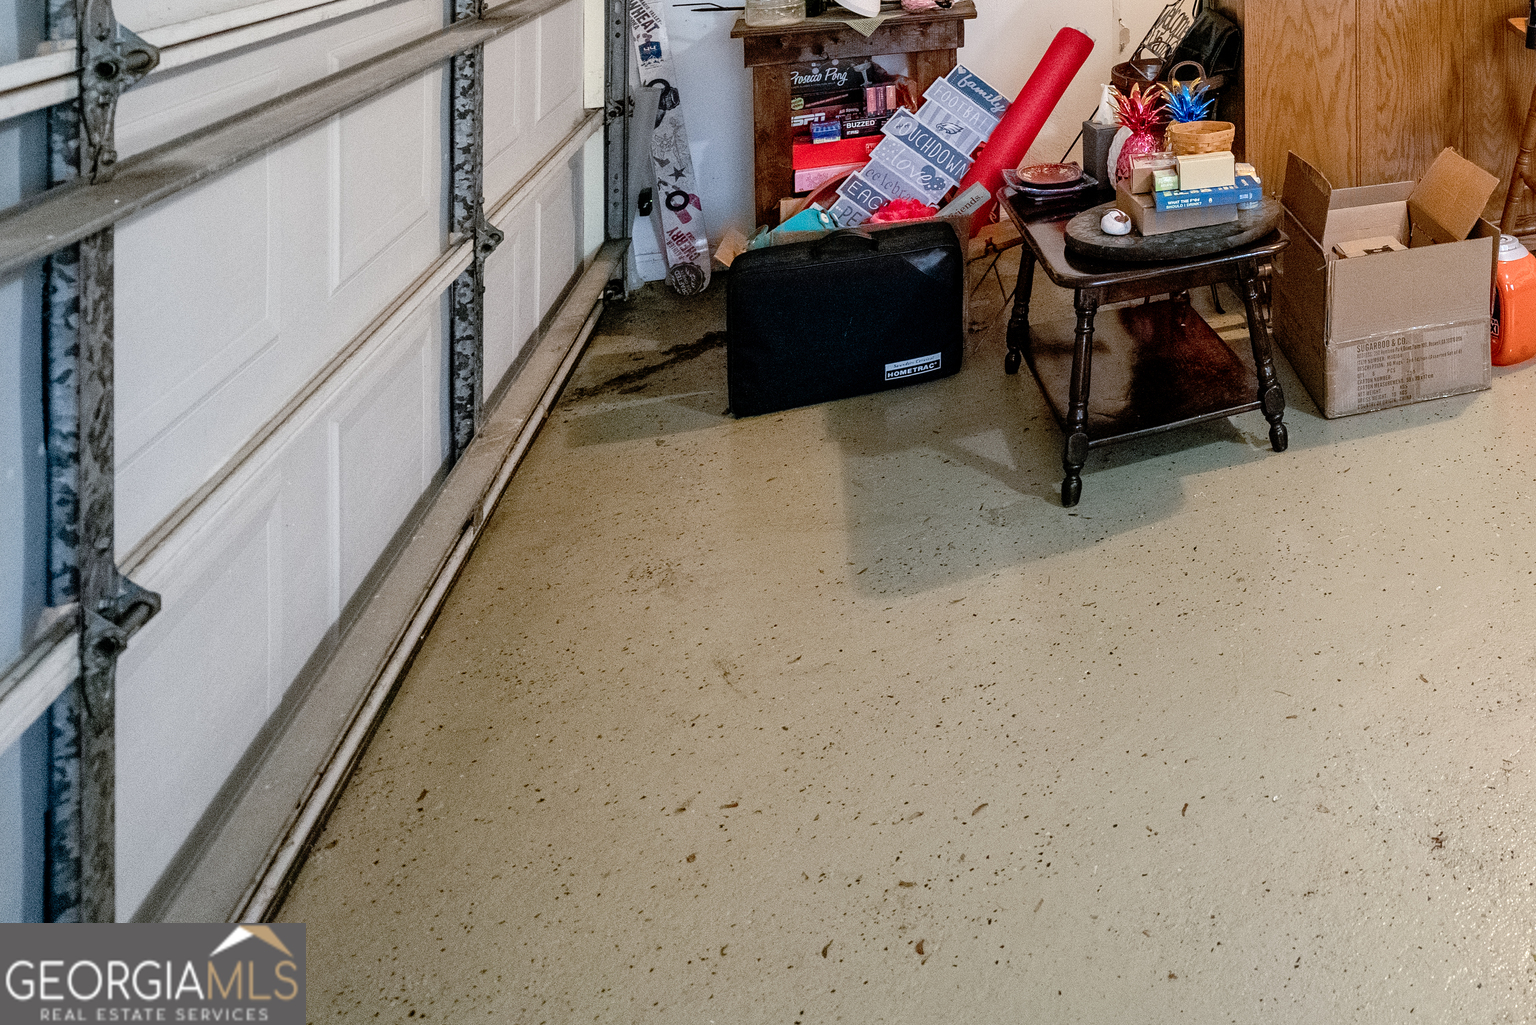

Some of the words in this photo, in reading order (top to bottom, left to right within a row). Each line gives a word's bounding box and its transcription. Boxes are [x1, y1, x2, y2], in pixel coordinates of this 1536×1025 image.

[790, 71, 822, 85] Prosecco
[825, 67, 848, 86] Pong
[958, 76, 1006, 113] family
[846, 120, 875, 129] BUZZED
[899, 116, 971, 180] TOUCHDOWN
[891, 148, 932, 186] love
[666, 226, 700, 261] CHERRY
[1356, 339, 1390, 353] SUGARBOO
[1391, 338, 1396, 347] &
[1397, 337, 1408, 346] CO.
[887, 363, 934, 378] HOMETRAC
